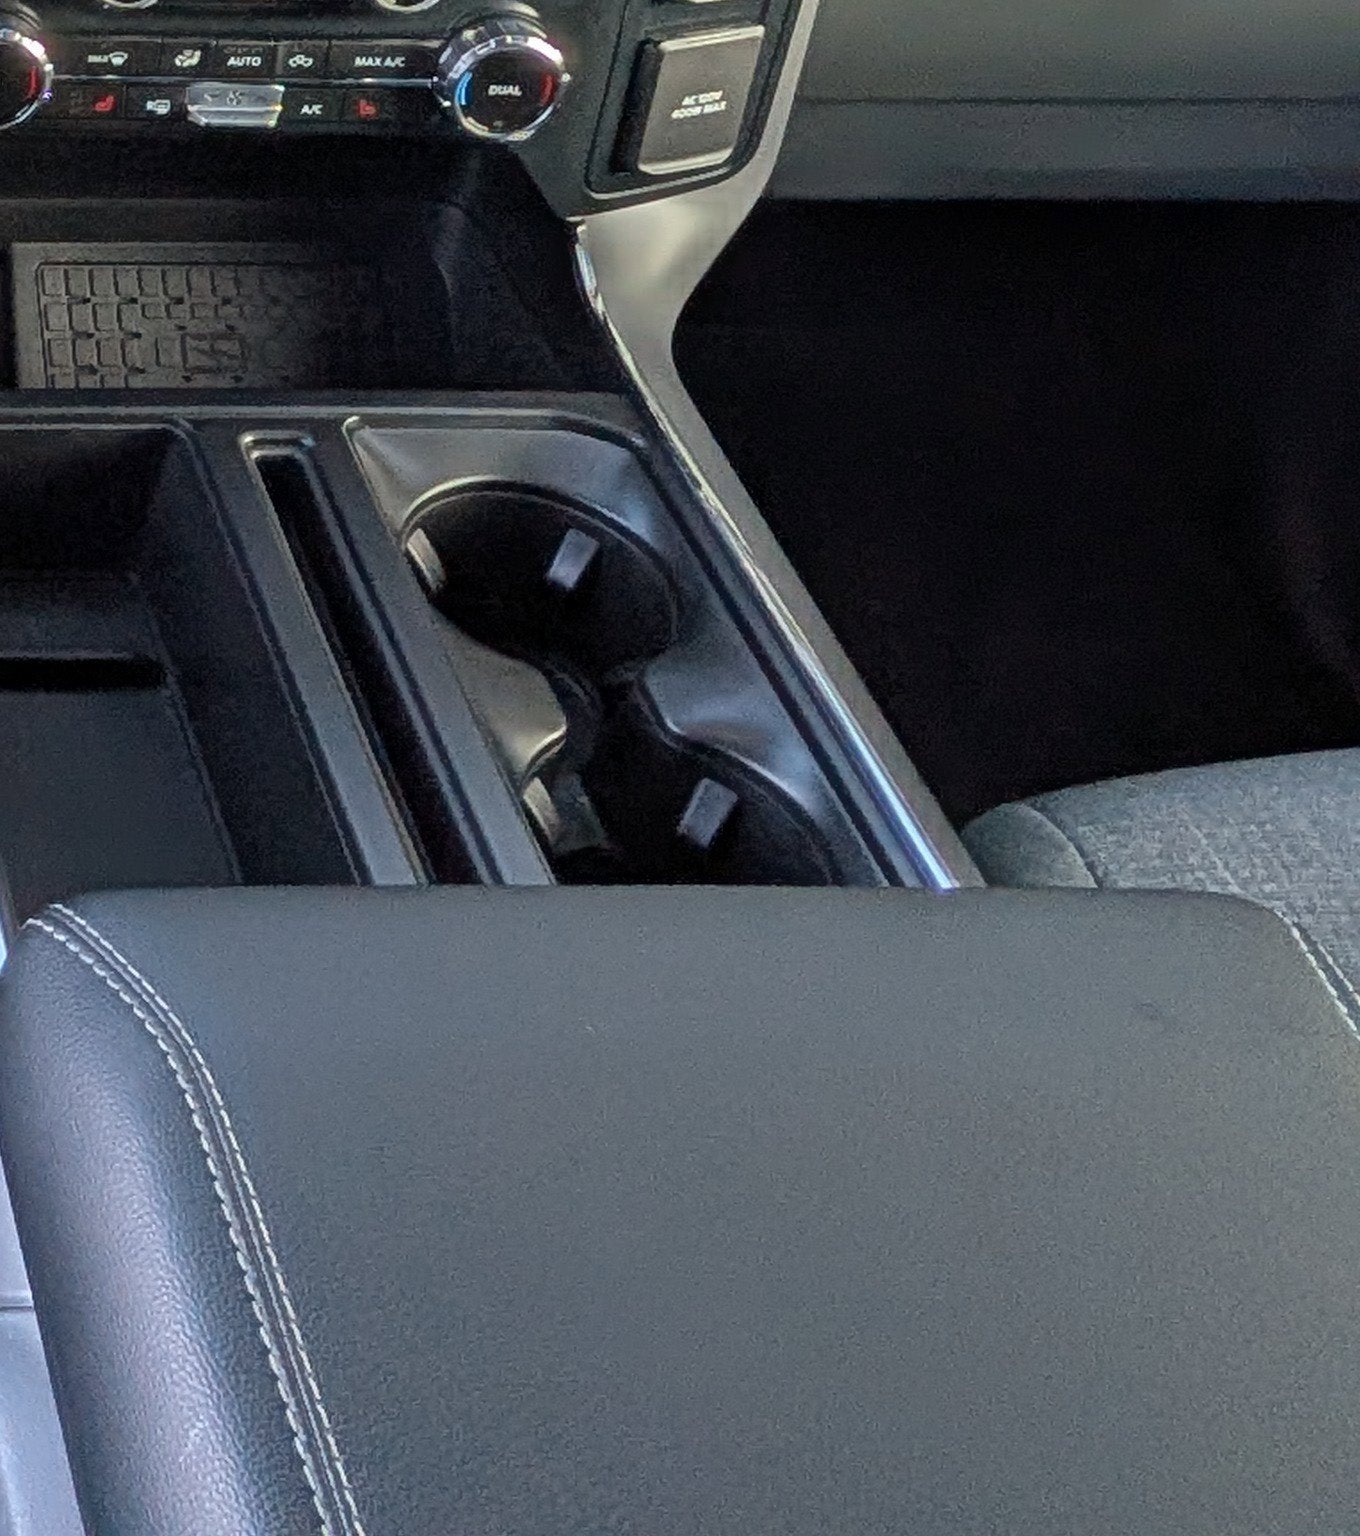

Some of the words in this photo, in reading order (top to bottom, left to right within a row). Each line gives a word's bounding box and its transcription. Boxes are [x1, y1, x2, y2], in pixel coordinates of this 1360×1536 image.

[227, 56, 262, 67] AUTO
[354, 56, 382, 67] MAX
[384, 56, 406, 68] A/C
[488, 85, 523, 96] DUAL
[301, 103, 324, 115] A/C
